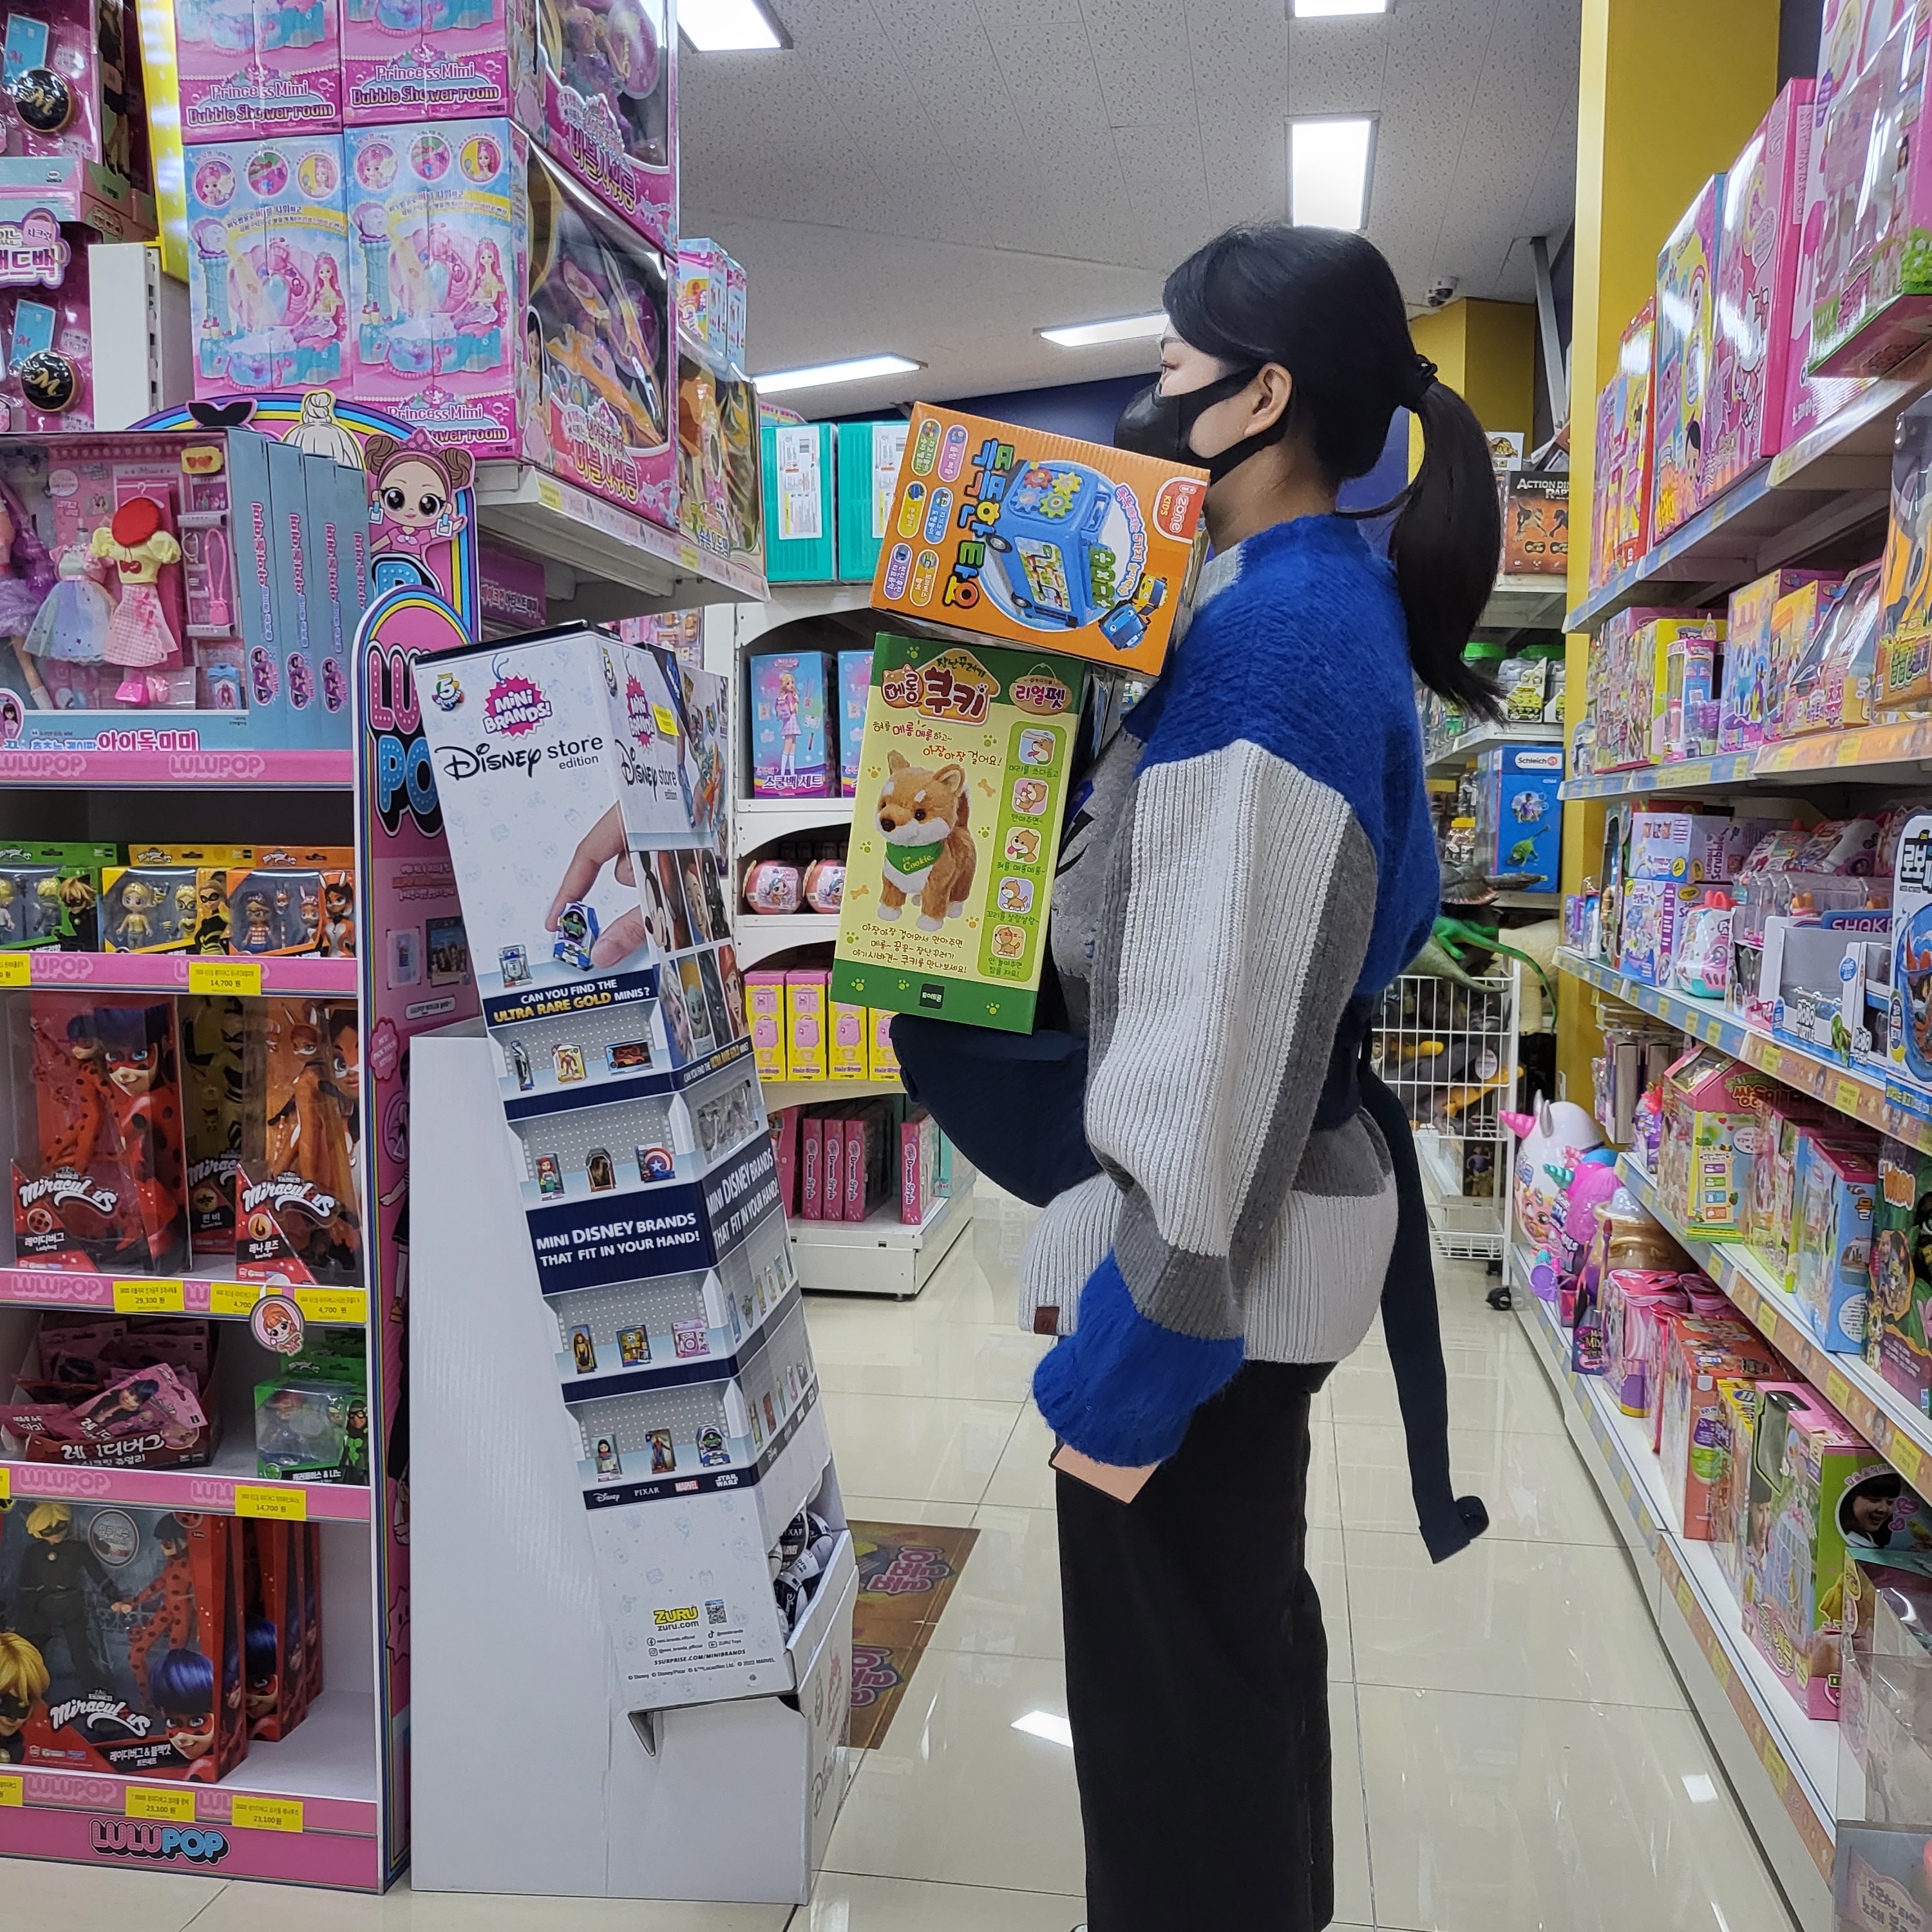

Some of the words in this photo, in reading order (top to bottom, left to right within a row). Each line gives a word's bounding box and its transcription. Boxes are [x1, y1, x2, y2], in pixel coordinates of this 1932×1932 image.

[376, 66, 440, 81] Princess
[442, 62, 475, 78] Mimi
[211, 83, 274, 101] Princess
[276, 81, 309, 97] Mimi
[352, 88, 399, 105] Bubble
[402, 86, 457, 102] Shower
[458, 85, 499, 100] room
[189, 106, 234, 124] Bubble
[291, 104, 334, 118] room
[27, 227, 53, 242] 시크릿
[388, 406, 450, 421] Princess
[451, 403, 483, 419] Mimi
[467, 427, 507, 441] room
[957, 439, 1014, 538] 똑똑한
[1517, 478, 1556, 489] ACTION
[1160, 495, 1171, 516] KIDS
[943, 540, 985, 609] 타요
[936, 656, 987, 678] 장난꾸러기
[884, 671, 920, 703] 메롱
[925, 666, 985, 717] 쿠키
[1015, 684, 1066, 709] 리얼펫
[483, 700, 552, 735] BRANDS!
[893, 721, 914, 737] 메롱
[547, 735, 604, 761] store
[922, 744, 966, 762] 아장아장
[967, 750, 1003, 767] 걸어요!
[170, 755, 261, 776] LULUPOP
[558, 753, 599, 771] edition
[1518, 757, 1548, 765] Schleich
[659, 768, 677, 787] store
[762, 774, 797, 790] 스쿨백
[798, 773, 824, 788] 세트
[862, 923, 897, 937] 아장아장
[899, 929, 930, 943] 걸어와서
[932, 934, 964, 949] 안아주면
[916, 945, 955, 960] 장난꾸러기
[900, 954, 925, 969] 쿠키를
[926, 960, 967, 974] 만나보세요!
[210, 979, 234, 988] 14,700
[234, 979, 242, 987] 원
[520, 990, 544, 1004] CAN
[545, 987, 569, 999] YOU
[571, 983, 596, 996] FIND
[596, 978, 618, 990] THE
[493, 1005, 534, 1023] ULTRA
[536, 1000, 571, 1016] RARE
[573, 994, 612, 1010] GOLD
[828, 1155, 837, 1179] Dream
[849, 1156, 858, 1180] Dream
[906, 1159, 914, 1184] Dream
[706, 1191, 724, 1218] MINI
[723, 1161, 750, 1204] DISNEY
[749, 1147, 774, 1182] BRANDS
[712, 1224, 730, 1251] THAT
[729, 1215, 741, 1236] FIT
[741, 1211, 748, 1227] IN
[746, 1196, 762, 1220] YOUR
[761, 1177, 781, 1209] HAND!
[24, 1232, 65, 1247] 레이디버그
[536, 1234, 570, 1250] MINI
[573, 1220, 634, 1244] DISNEY
[636, 1213, 697, 1233] BRANDS
[540, 1251, 573, 1267] THAT
[578, 1247, 597, 1261] FIT
[600, 1245, 615, 1257] IN
[618, 1238, 654, 1254] YOUR
[656, 1231, 701, 1248] HAND!
[11, 1274, 104, 1302] LULUPOP
[135, 1296, 158, 1305] 29,300
[318, 1306, 339, 1314] 4,700
[19, 1470, 111, 1493] LULUPOP
[675, 1480, 699, 1493] MARVEL
[715, 1473, 739, 1483] STAR
[715, 1479, 739, 1488] WARS
[592, 1492, 620, 1503] Disney
[634, 1486, 661, 1498] PIXAR
[256, 1504, 279, 1513] 14,700
[654, 1606, 699, 1625] ZURU
[657, 1620, 700, 1632] zuru.com
[109, 1746, 144, 1763] 레이디버그
[26, 1775, 117, 1801] LULUPOP
[146, 1804, 169, 1814] 23,100
[169, 1806, 176, 1815] 원
[252, 1815, 276, 1824] 23,100
[275, 1817, 283, 1826] 원
[91, 1821, 223, 1859] LULUPOP
